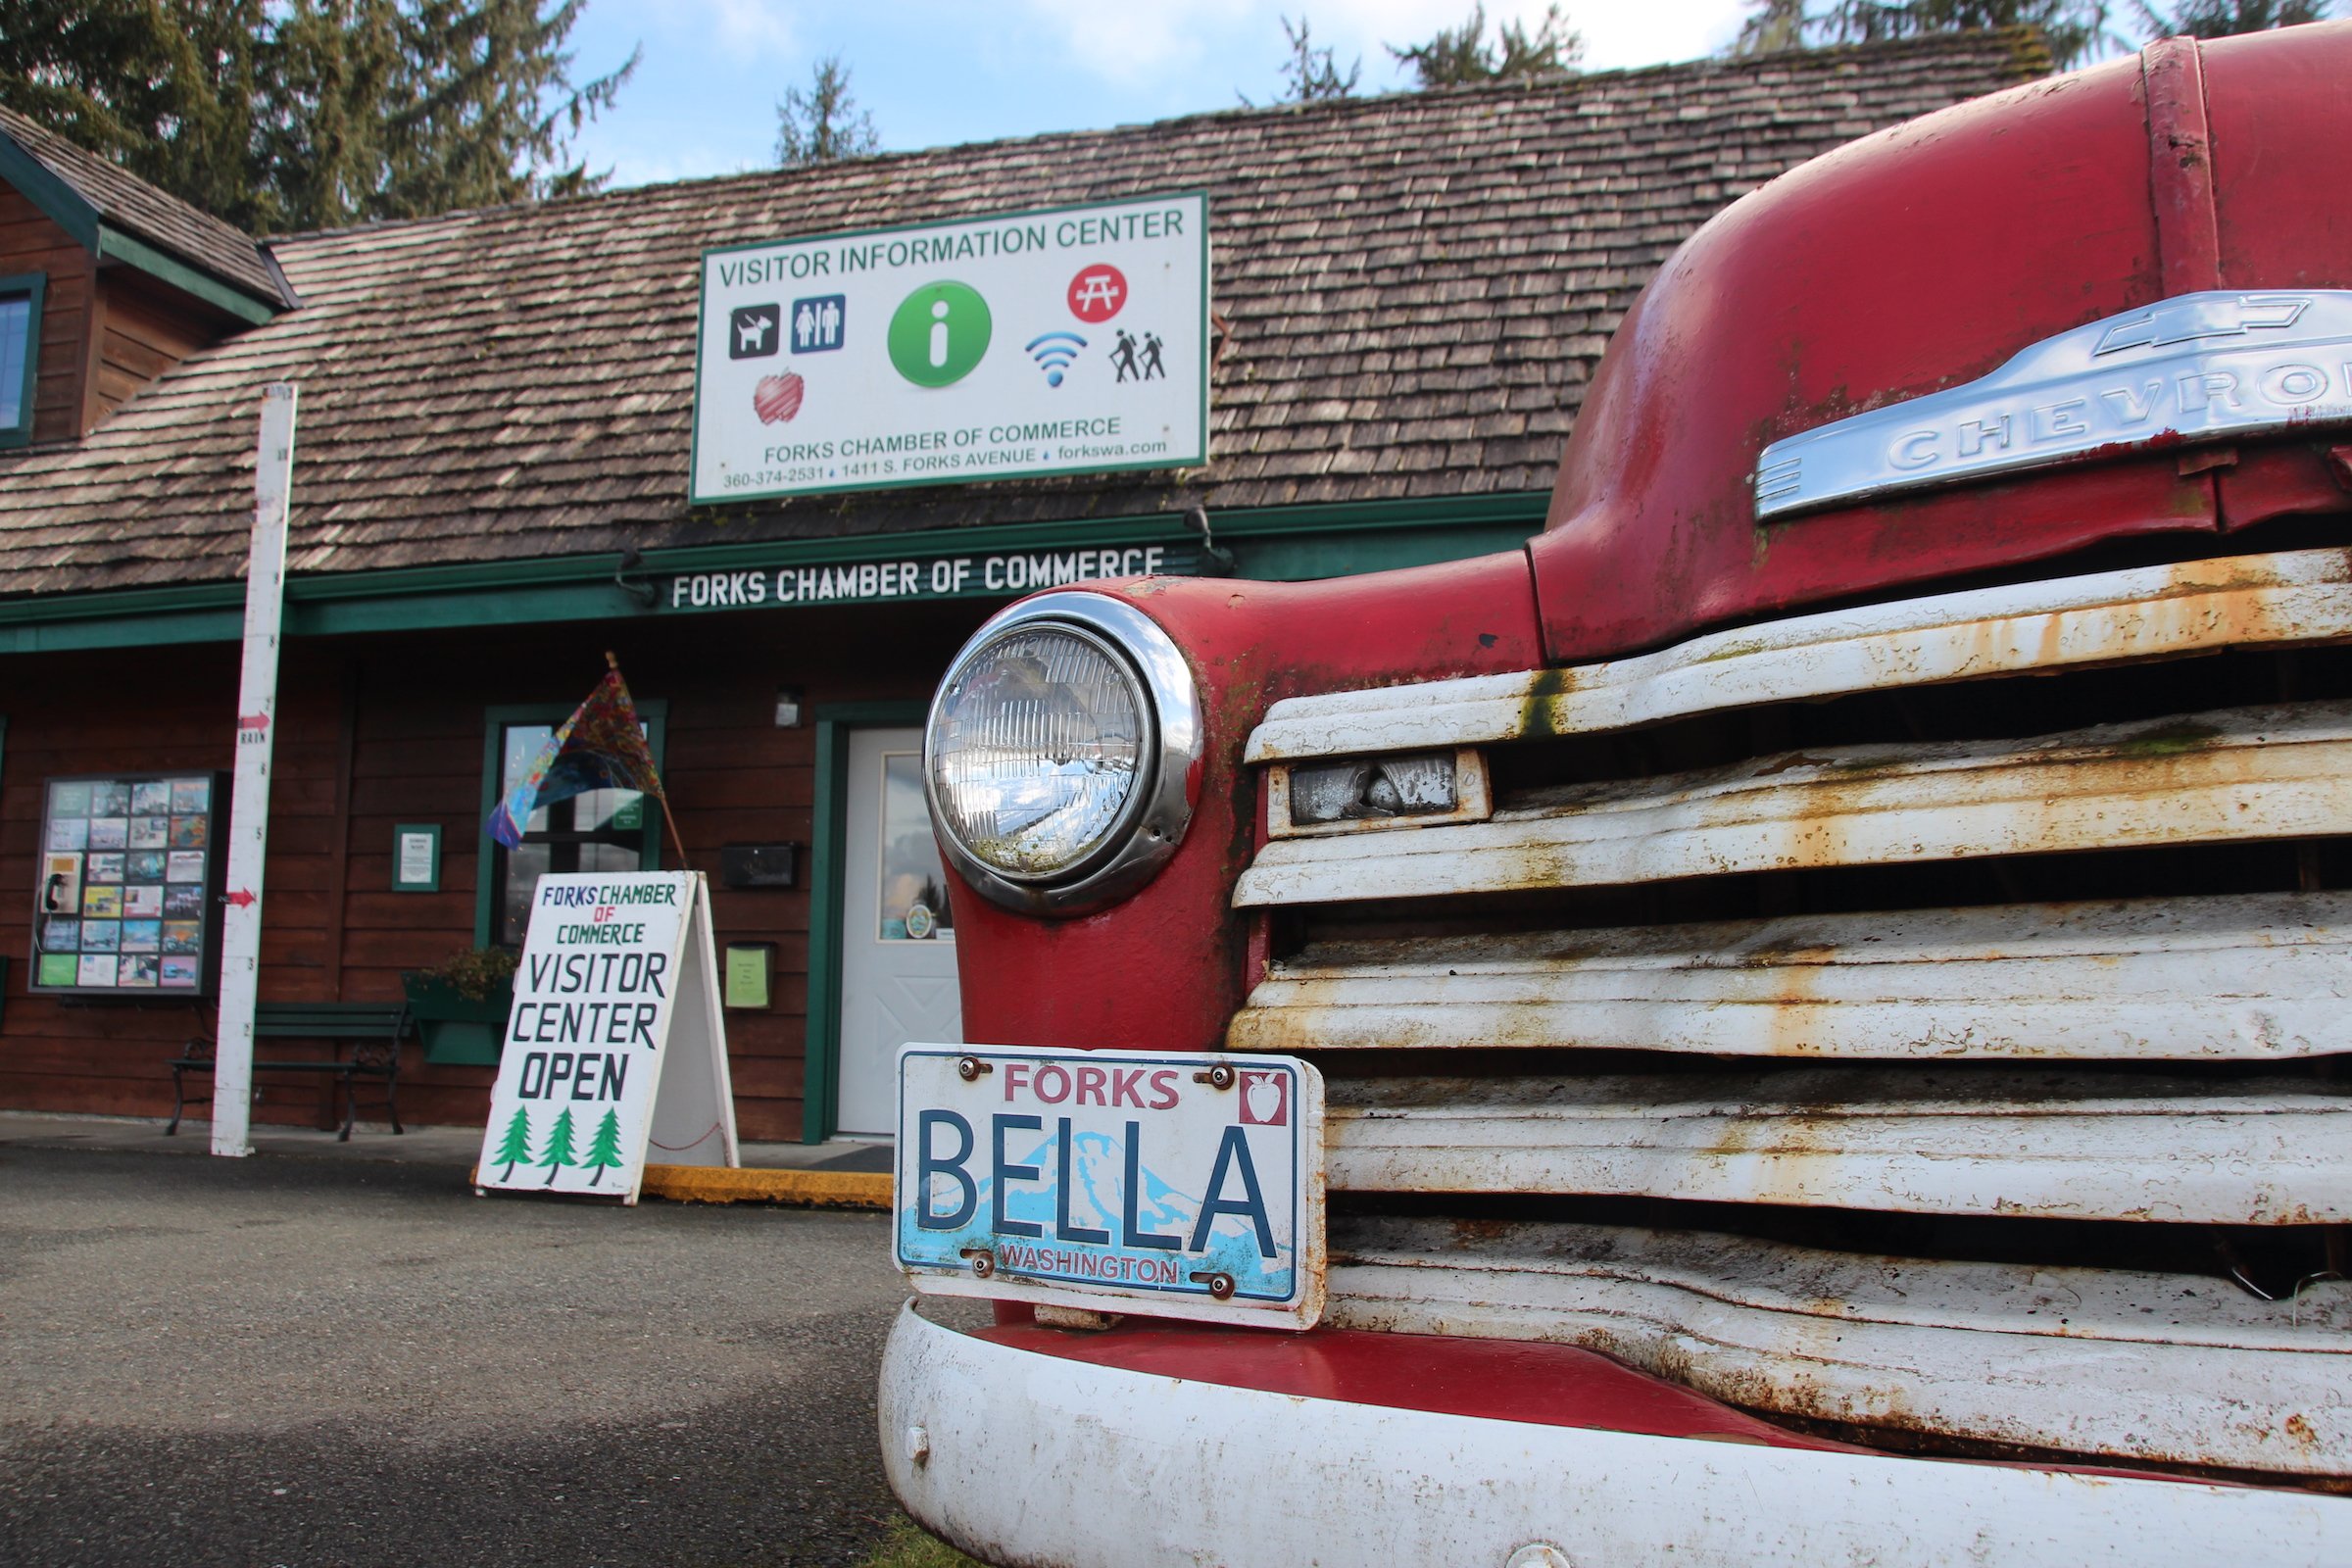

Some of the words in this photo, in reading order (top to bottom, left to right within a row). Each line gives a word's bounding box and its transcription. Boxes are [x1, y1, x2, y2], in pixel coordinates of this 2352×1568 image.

[719, 250, 830, 288] VISITOR
[840, 223, 1046, 273] INFORMATION
[1056, 209, 1184, 248] CENTER
[764, 441, 834, 465] FORKS
[841, 430, 947, 457] CHAMBER
[954, 427, 982, 447] OF
[989, 416, 1121, 444] COMMERCE
[1887, 363, 2352, 470] CHEVRO
[723, 466, 824, 489] 360-374-2531
[842, 462, 878, 477] 1411
[884, 460, 898, 473] S.
[903, 452, 960, 471] FORKS
[965, 448, 1036, 467] AVENUE
[1058, 441, 1167, 460] forkswa.com
[672, 571, 766, 609] FORKS
[776, 561, 919, 603] CHAMBER
[931, 558, 972, 594] OF
[984, 546, 1164, 591] COMMERCE
[542, 887, 597, 907] FORKS
[599, 884, 676, 906] CHAMBER
[594, 907, 615, 922] OF
[557, 923, 645, 946] COMMERCE
[530, 953, 666, 999] VISITOR
[513, 1003, 657, 1051] CENTER
[517, 1052, 629, 1102] OPEN
[1004, 1064, 1179, 1109] FORKS
[916, 1109, 1278, 1258] BELLA
[1001, 1245, 1178, 1284] WASHINGTON
